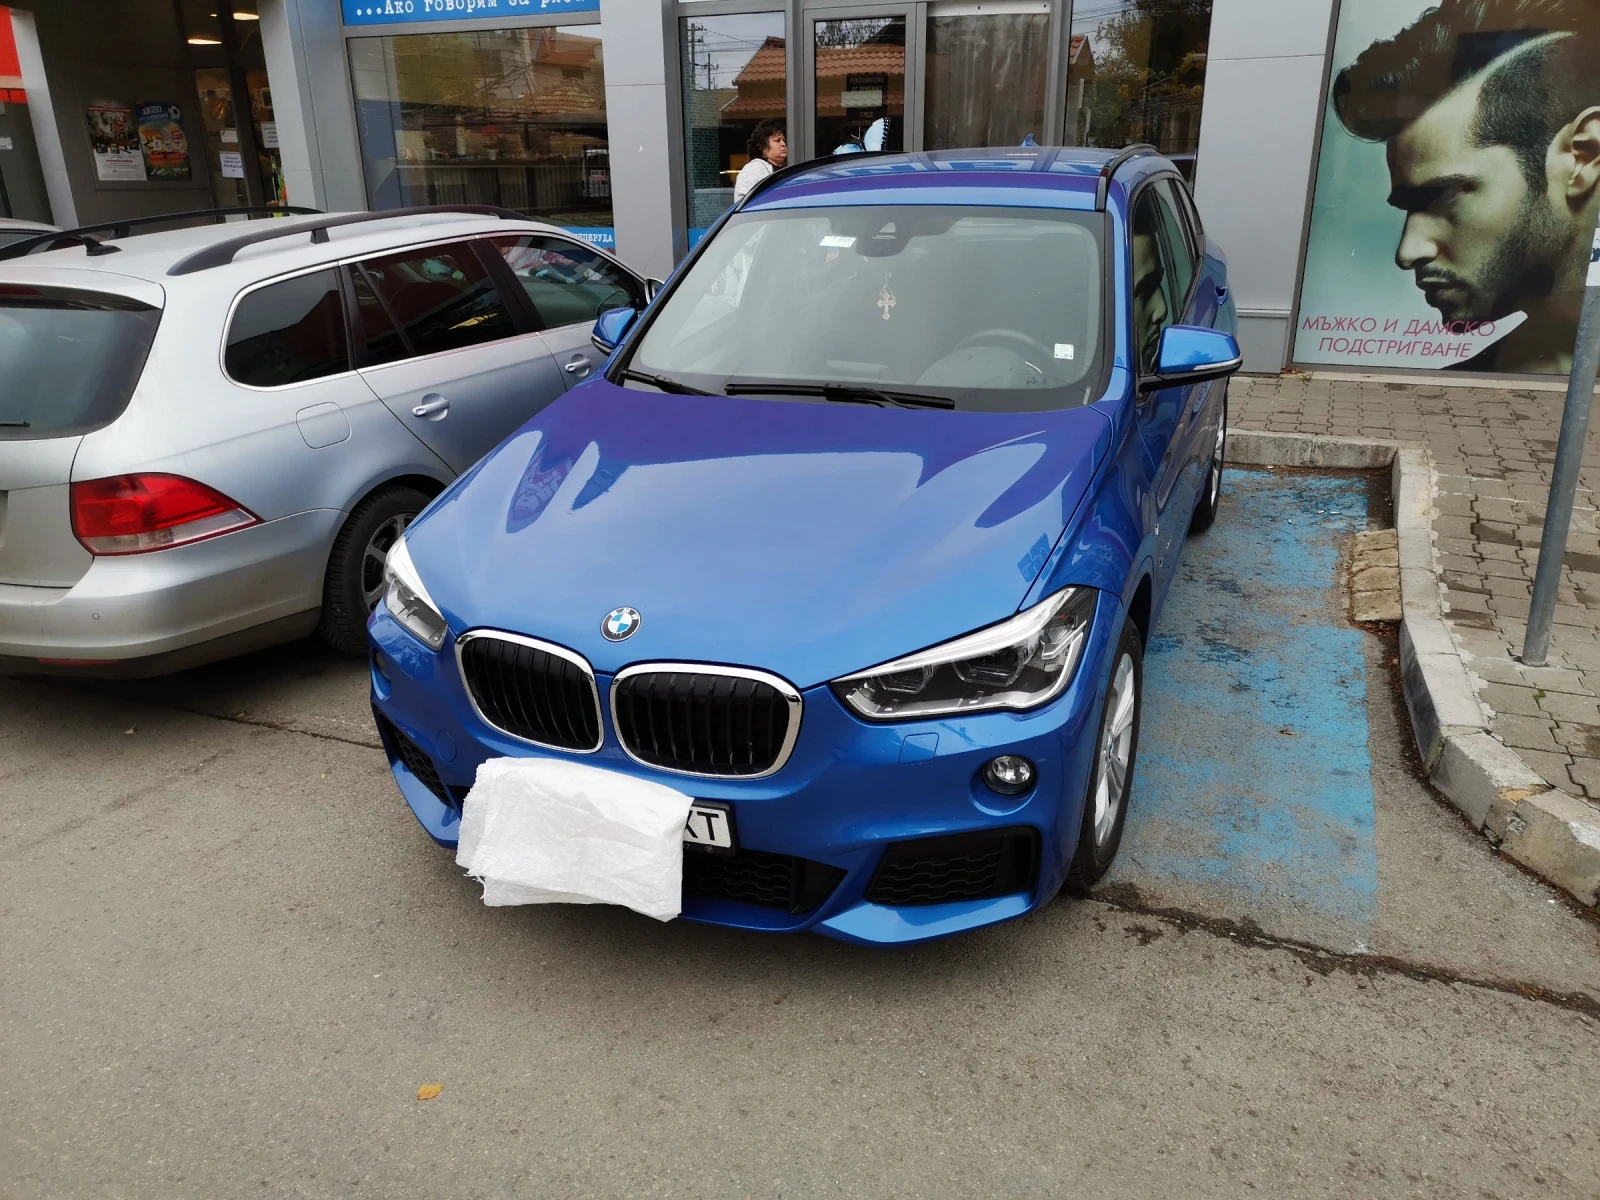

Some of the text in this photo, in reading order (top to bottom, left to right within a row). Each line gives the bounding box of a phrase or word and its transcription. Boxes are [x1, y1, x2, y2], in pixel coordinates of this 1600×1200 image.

[423, 0, 497, 13] говорим
[574, 233, 613, 242] ПЕРУДА
[1302, 316, 1496, 336] МЪЖКО И ДАМСКО
[1318, 337, 1473, 358] ПОДСТРИГВАНЕ
